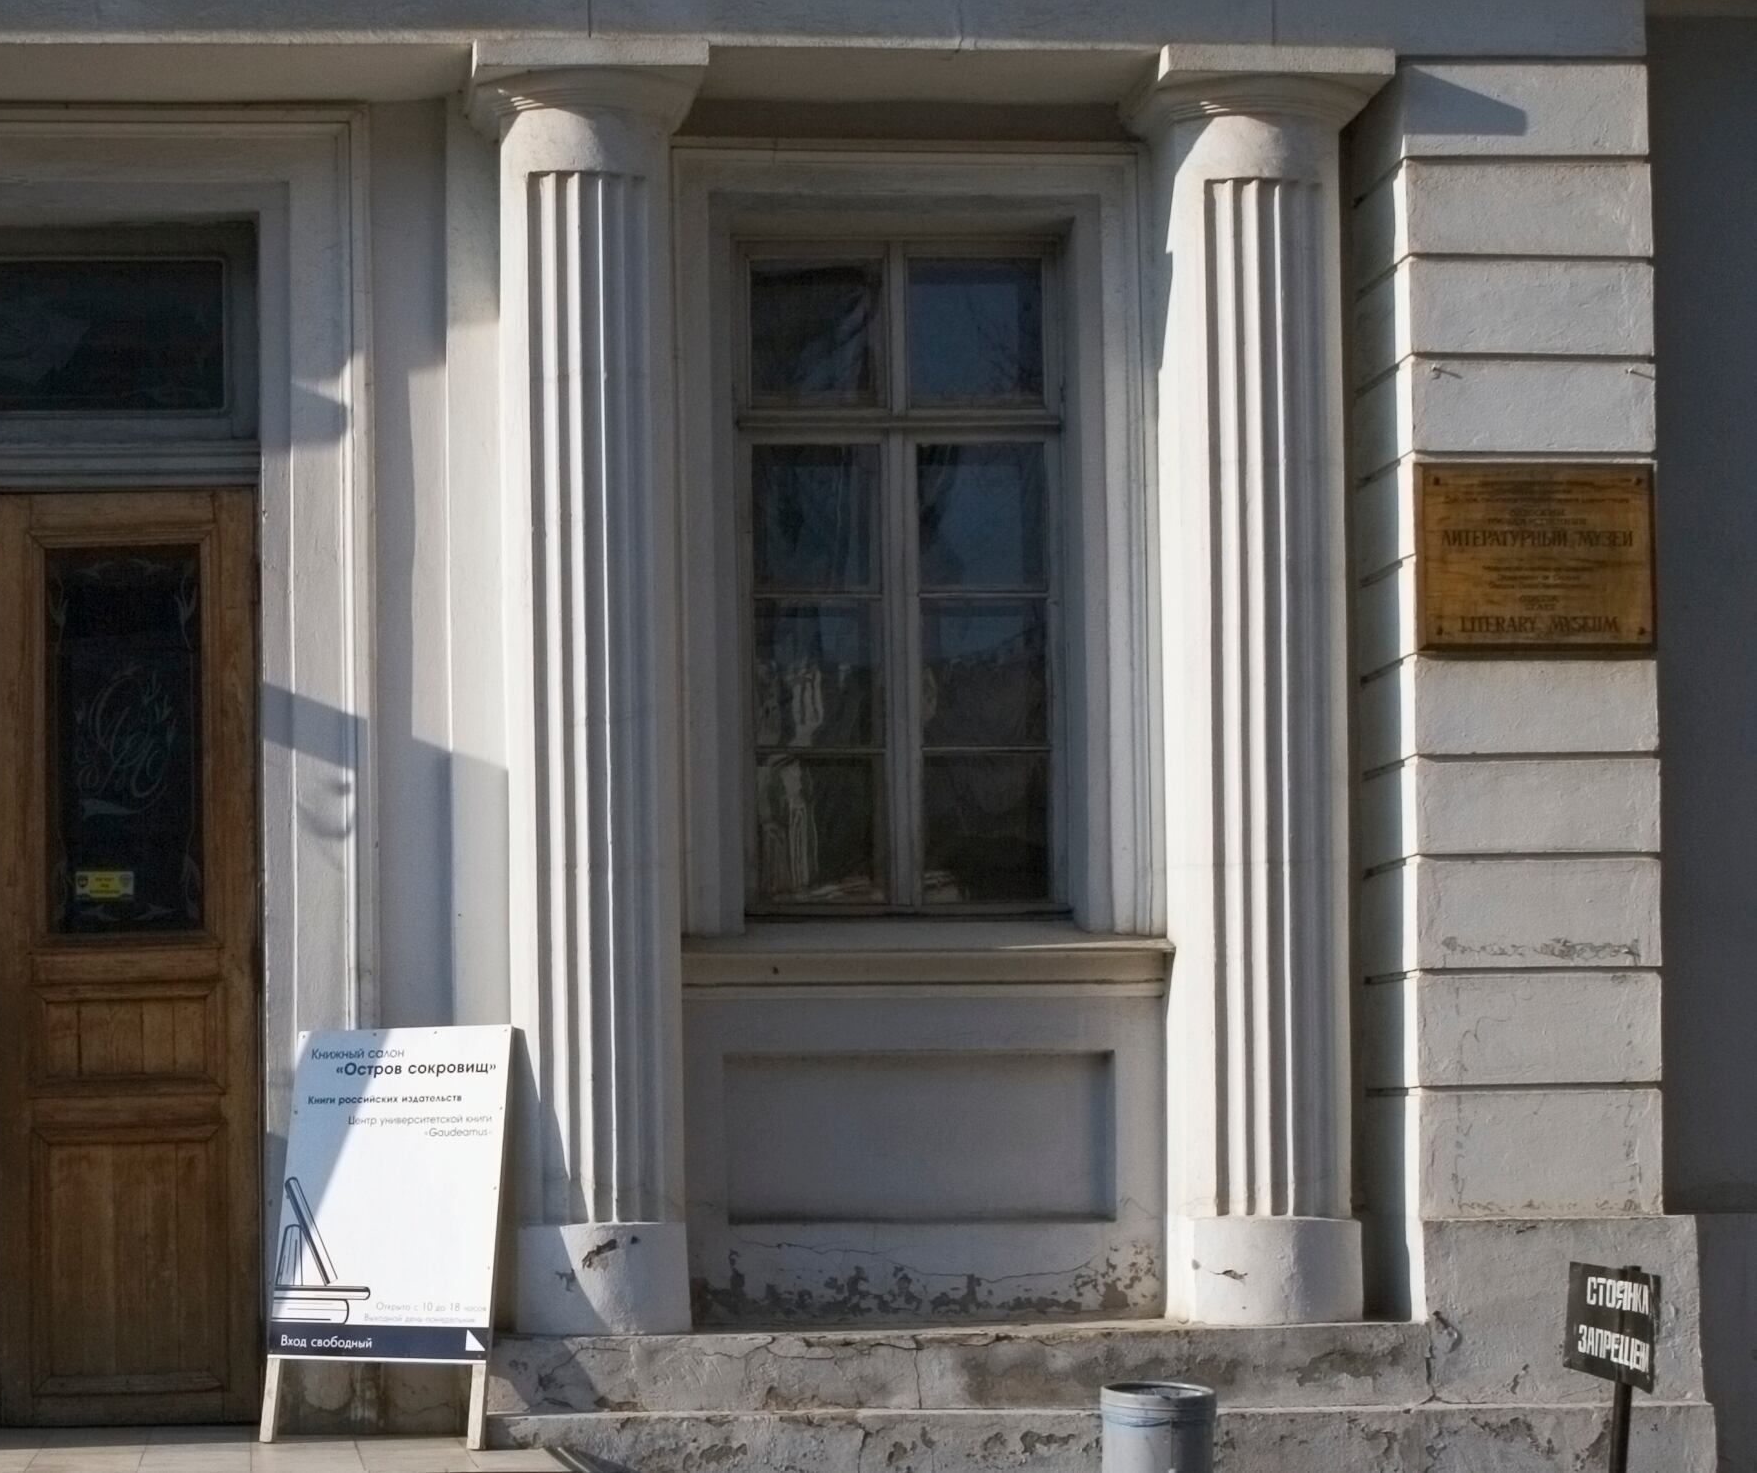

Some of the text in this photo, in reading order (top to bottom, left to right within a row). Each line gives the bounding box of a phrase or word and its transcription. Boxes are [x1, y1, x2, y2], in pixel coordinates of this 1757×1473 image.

[1459, 615, 1537, 633] LITERARY
[311, 1047, 405, 1060] Книжный салон
[336, 1062, 497, 1078] «Остров сокровищ»
[307, 1093, 463, 1106] Книги российских издательств
[348, 1115, 377, 1127] Центр
[380, 1114, 463, 1127] университетской
[1586, 1276, 1649, 1314] СТОЯНКА
[422, 1302, 433, 1312] 10
[450, 1302, 460, 1312] 18
[280, 1334, 373, 1349] Вход свободный
